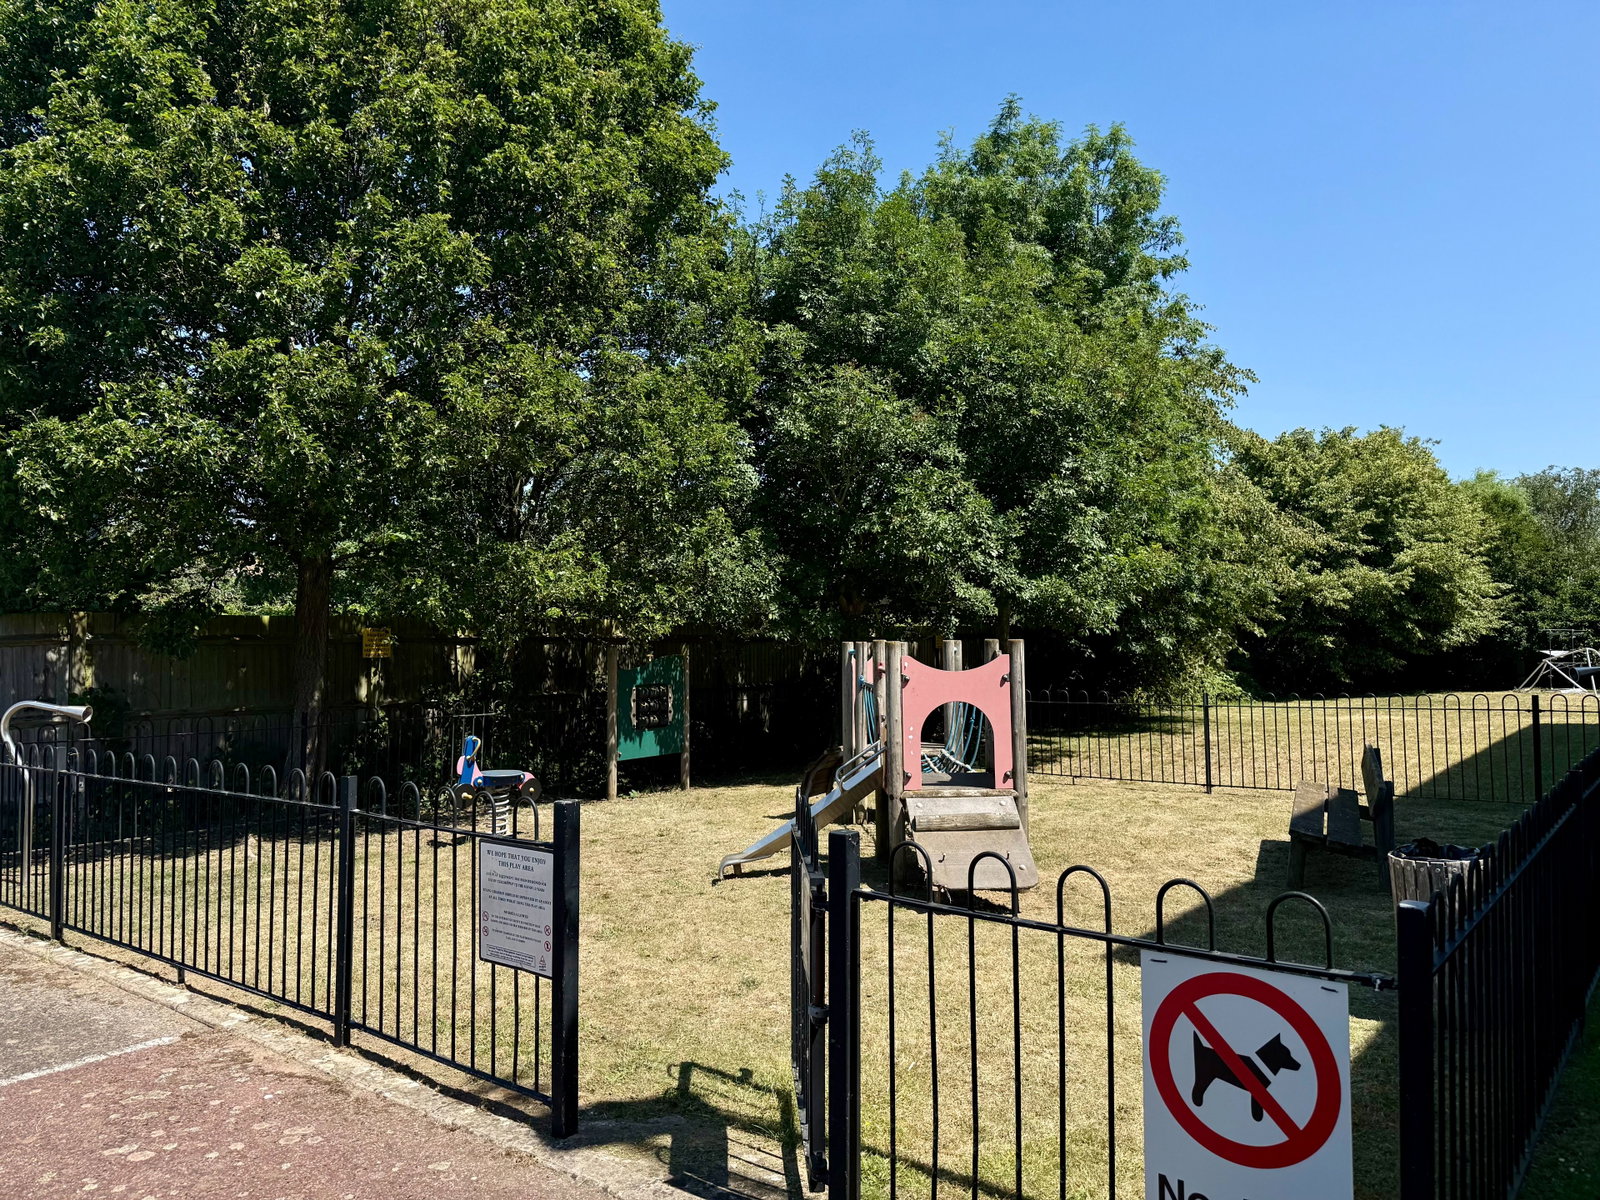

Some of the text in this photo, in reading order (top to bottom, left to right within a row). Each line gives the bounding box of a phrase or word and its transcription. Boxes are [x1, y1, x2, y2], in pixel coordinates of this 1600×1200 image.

[487, 849, 546, 866] WE HOPE THAT YOU ENJOY
[498, 860, 535, 872] THIS PLAY AREA
[1158, 1173, 1210, 1200] N
